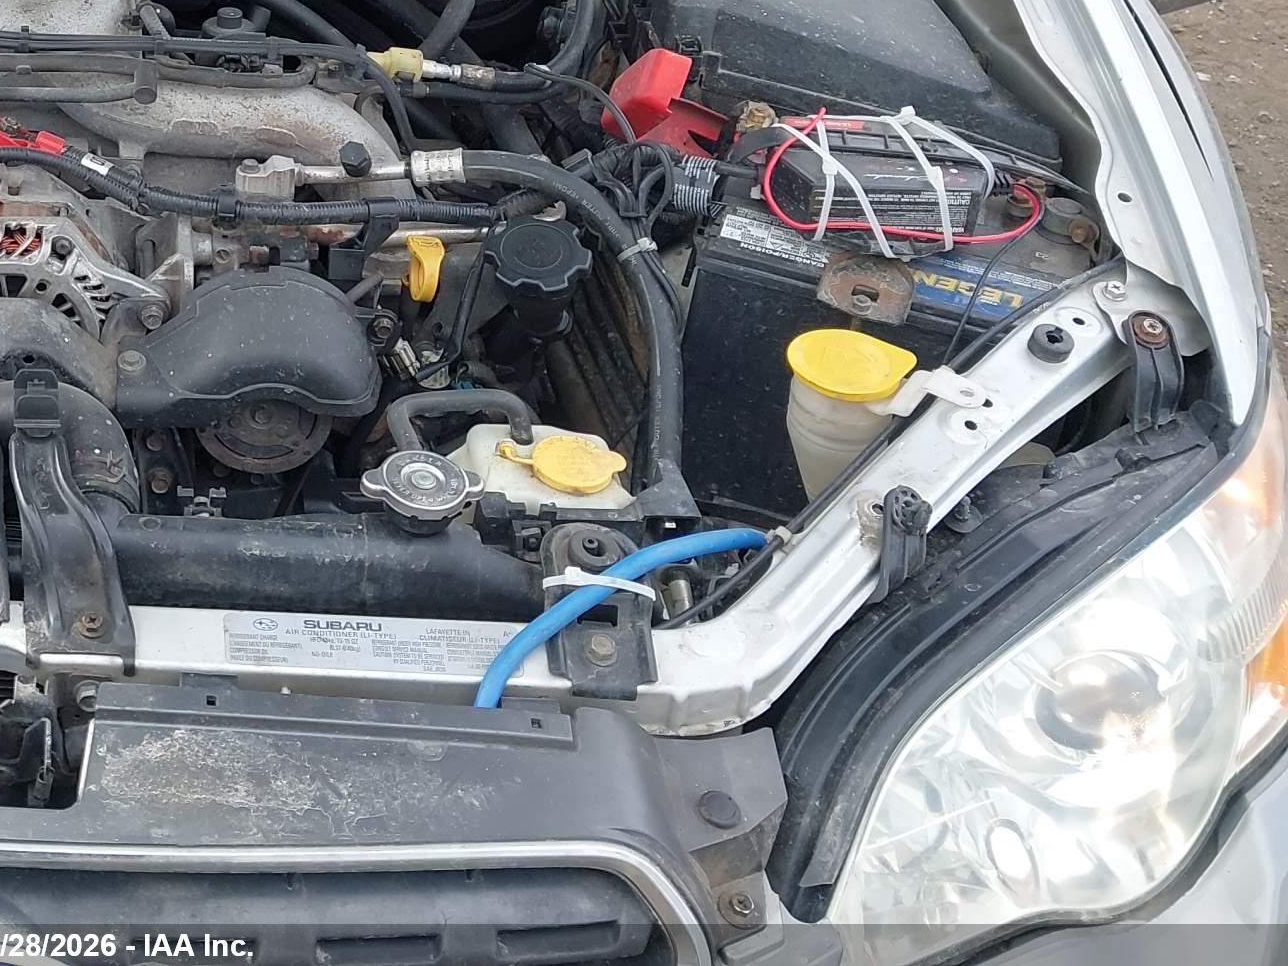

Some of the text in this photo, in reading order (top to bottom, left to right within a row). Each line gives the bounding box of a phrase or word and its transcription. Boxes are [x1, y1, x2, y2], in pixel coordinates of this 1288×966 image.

[910, 269, 1025, 309] LEGEN
[304, 619, 382, 632] SUBARU
[285, 628, 300, 636] AIR
[302, 630, 359, 639] CONDITIONER
